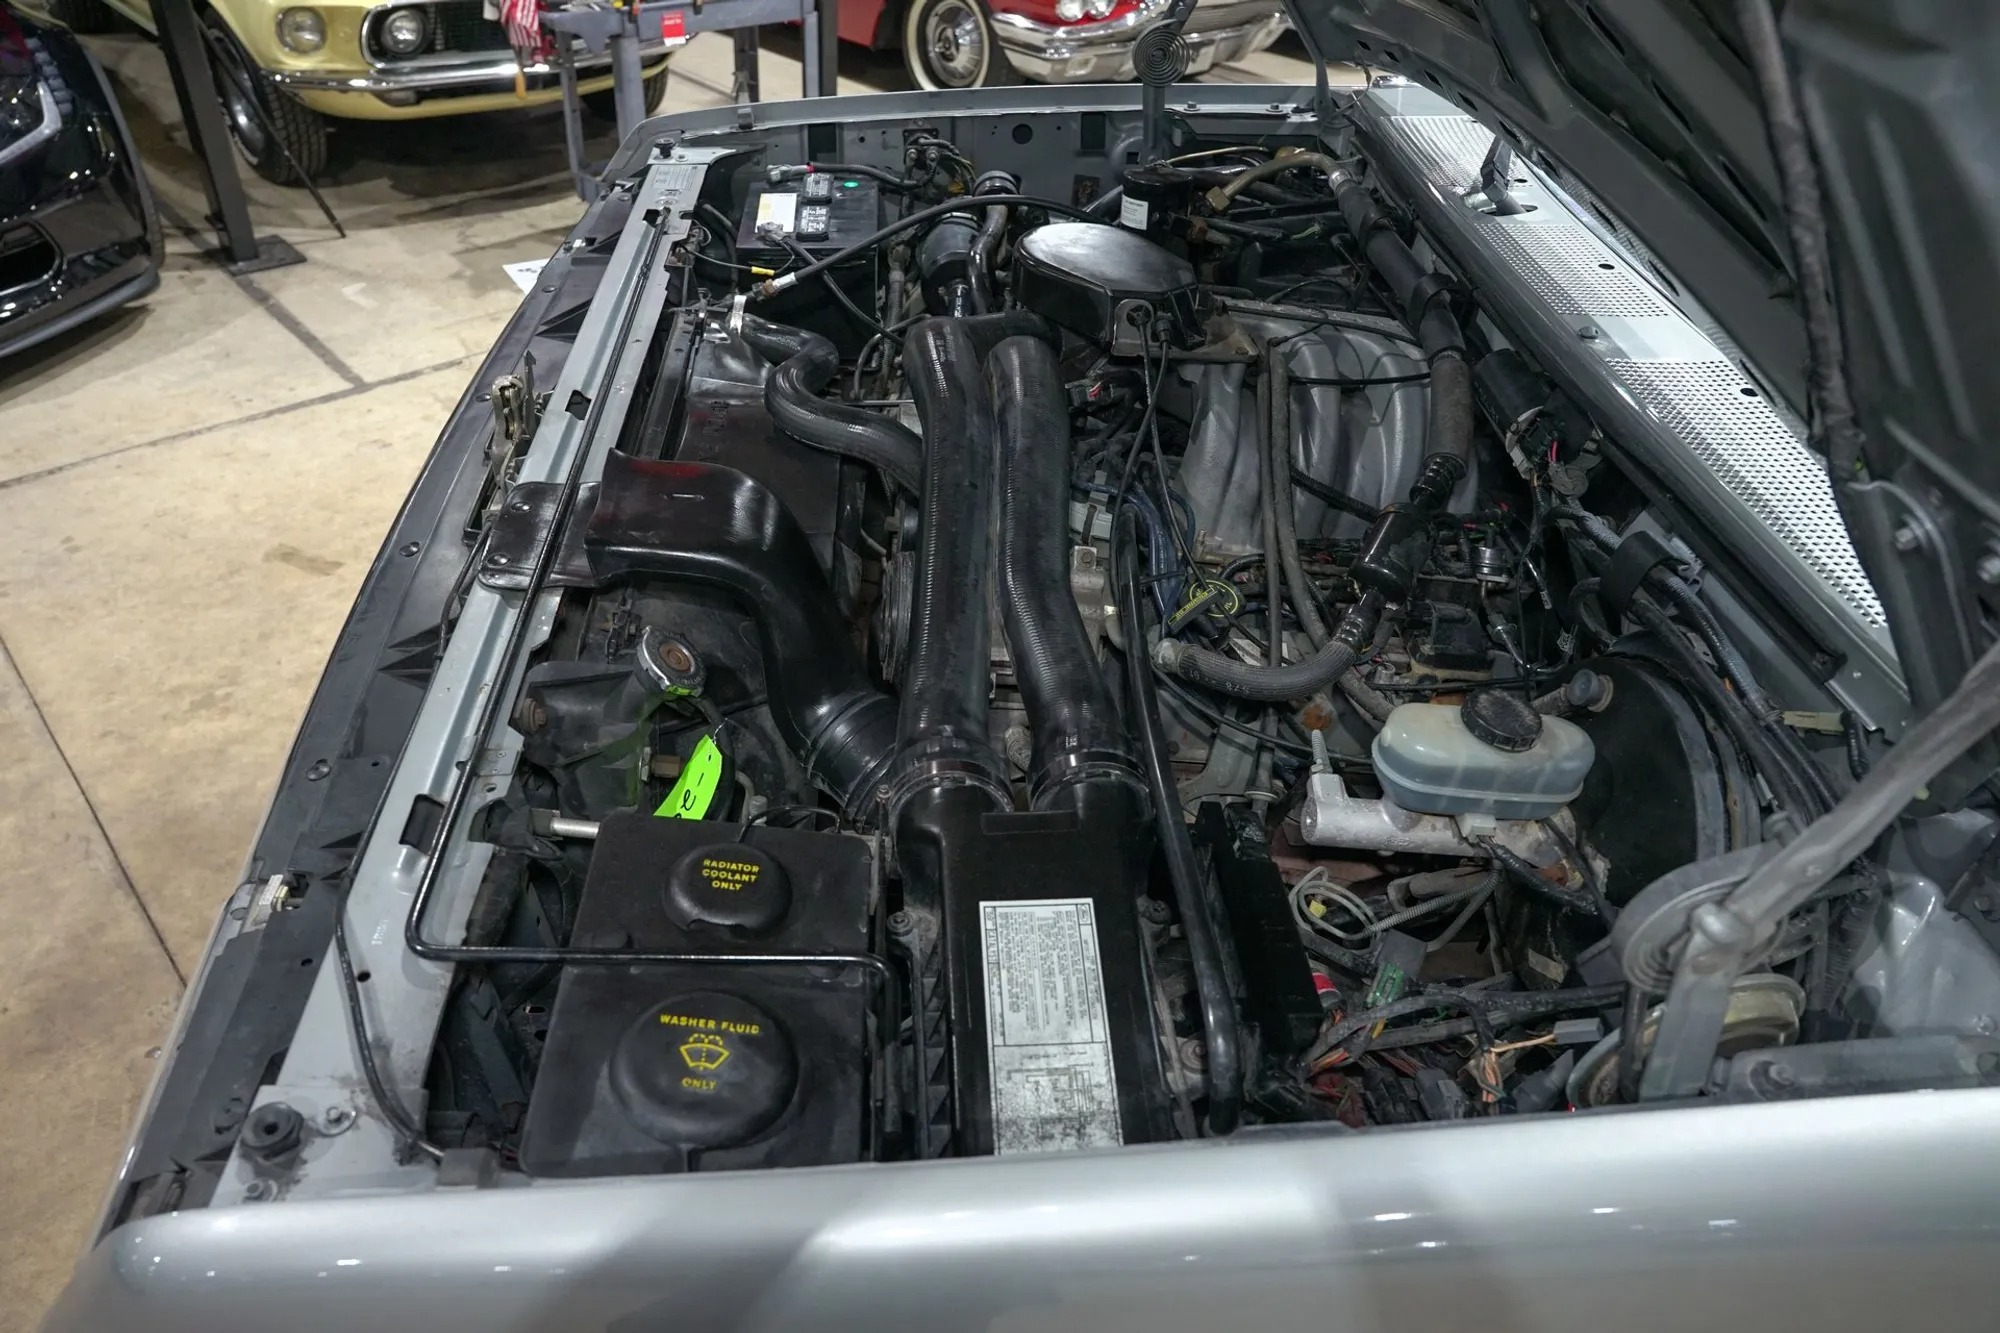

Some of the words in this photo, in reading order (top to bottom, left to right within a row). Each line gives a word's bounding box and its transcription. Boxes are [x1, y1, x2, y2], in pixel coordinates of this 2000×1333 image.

[703, 859, 760, 873] RADIATOR
[702, 868, 758, 883] COOLANT
[711, 880, 742, 891] ONLY
[659, 1014, 716, 1030] WASHER
[721, 1021, 760, 1035] FLUID
[681, 1076, 717, 1090] ONLY
